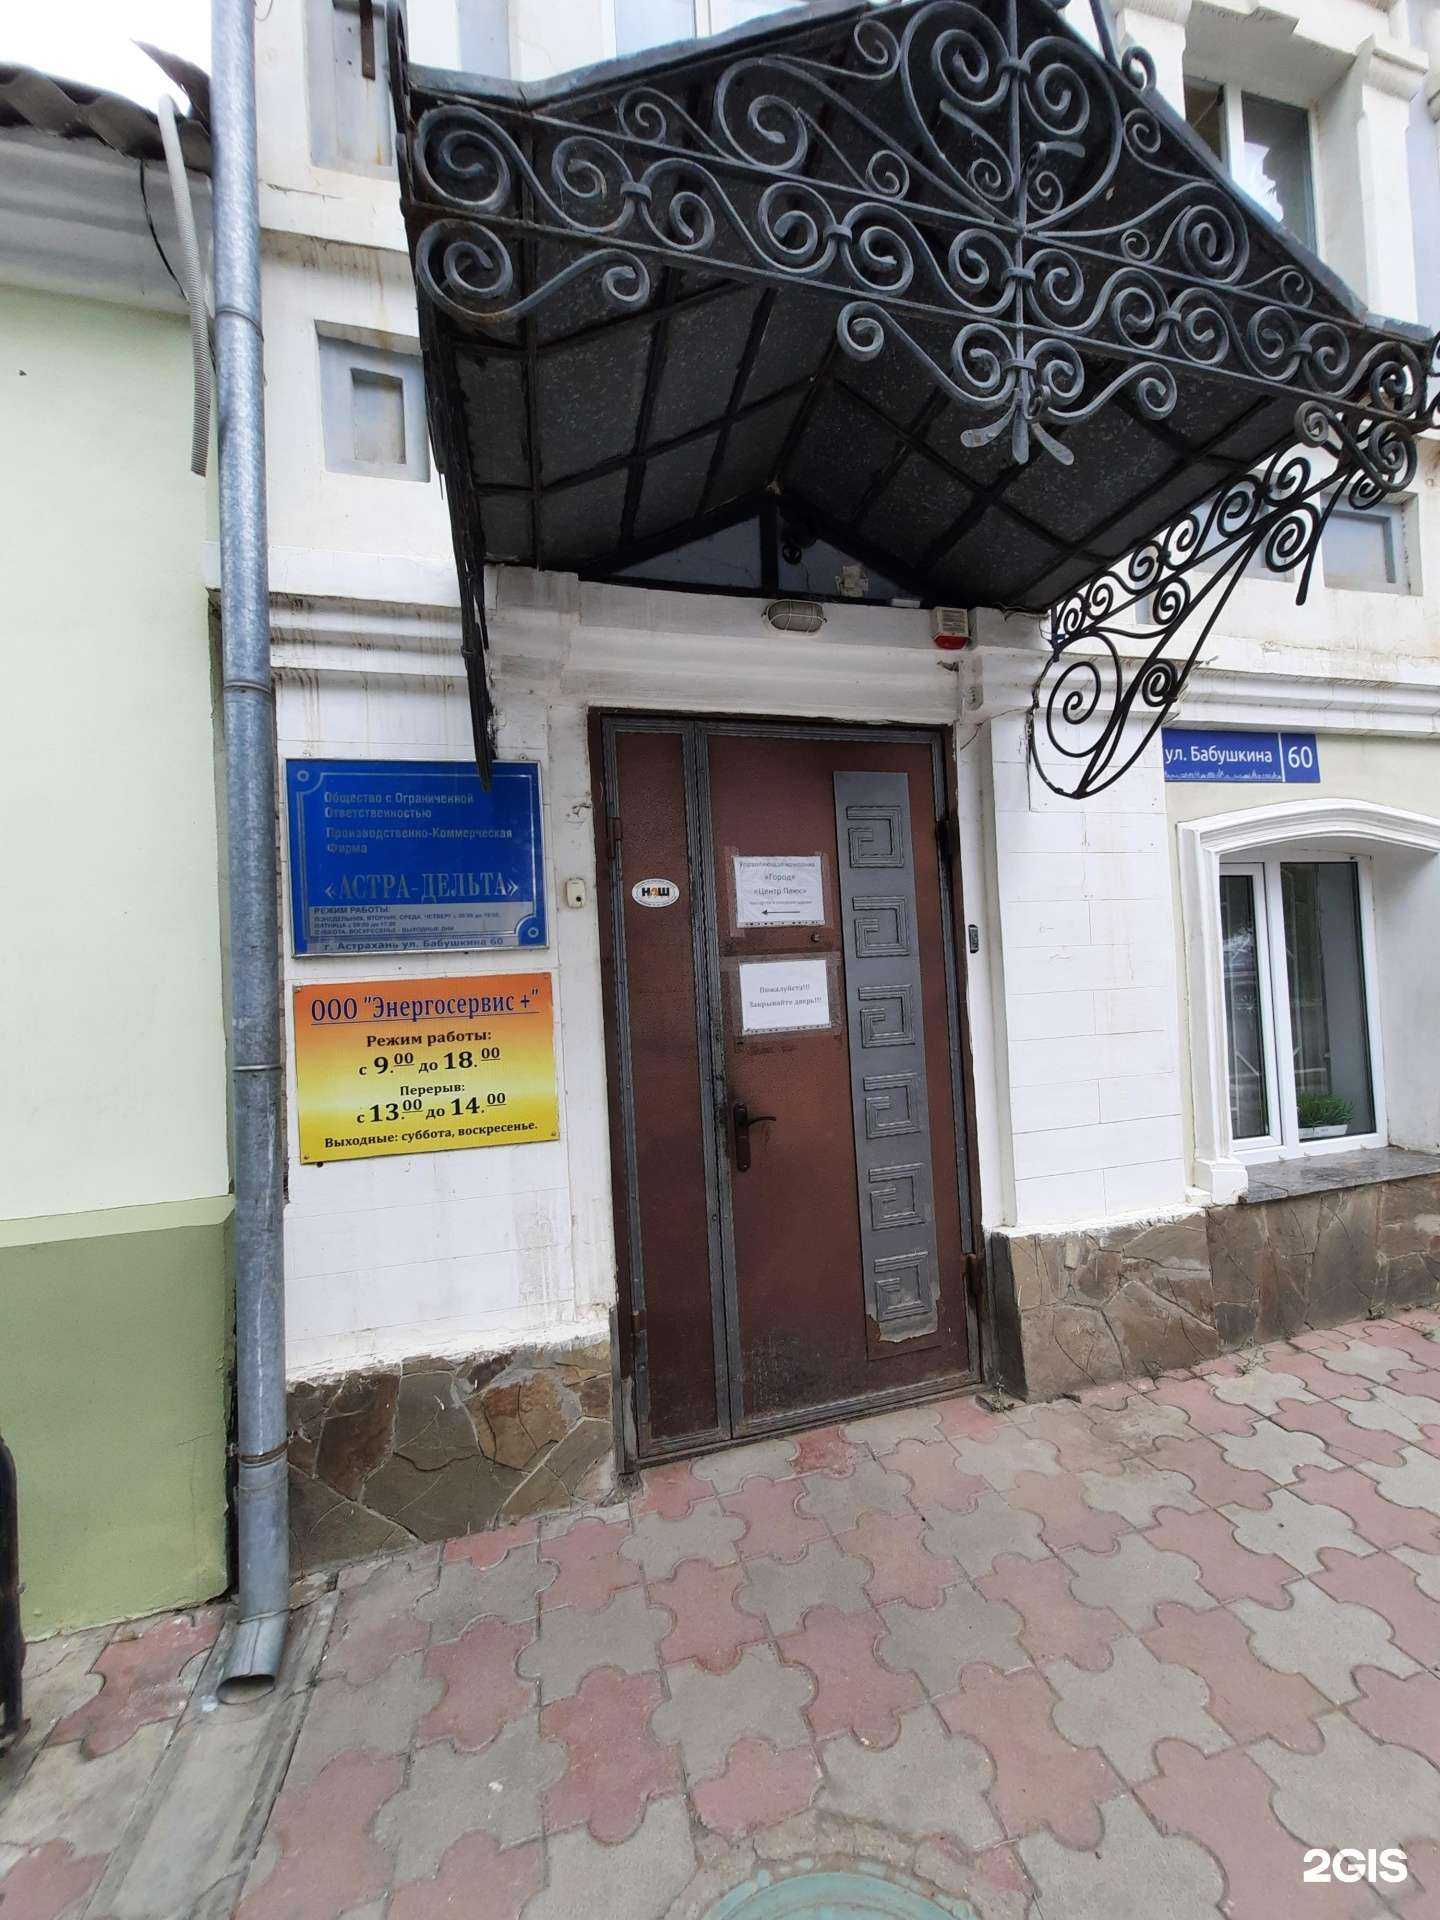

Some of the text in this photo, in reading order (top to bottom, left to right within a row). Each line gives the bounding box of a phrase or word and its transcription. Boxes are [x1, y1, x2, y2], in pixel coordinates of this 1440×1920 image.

[1164, 745, 1313, 769] ул. Бабушкина 60
[324, 791, 382, 804] Общество
[395, 792, 475, 806] Ограниченной
[324, 807, 432, 818] Ответственностью
[326, 827, 513, 840] Производственно-Коммерческая
[327, 843, 368, 856] Фирма
[314, 907, 347, 915] РЕЖИМ
[338, 942, 399, 953] Астрахань
[402, 941, 419, 950] ул.
[423, 937, 487, 949] Бабушкина
[490, 937, 503, 946] 60
[311, 997, 358, 1022] ООО
[364, 993, 514, 1022] "Энергосервис
[366, 1030, 492, 1048] Режим работы:
[358, 1064, 368, 1076] с
[418, 1060, 438, 1074] до
[399, 1083, 466, 1097] Перерыв:
[356, 1113, 366, 1124] с
[426, 1105, 445, 1119] до
[324, 1121, 539, 1148] Выходные: суббота, воскресенье.
